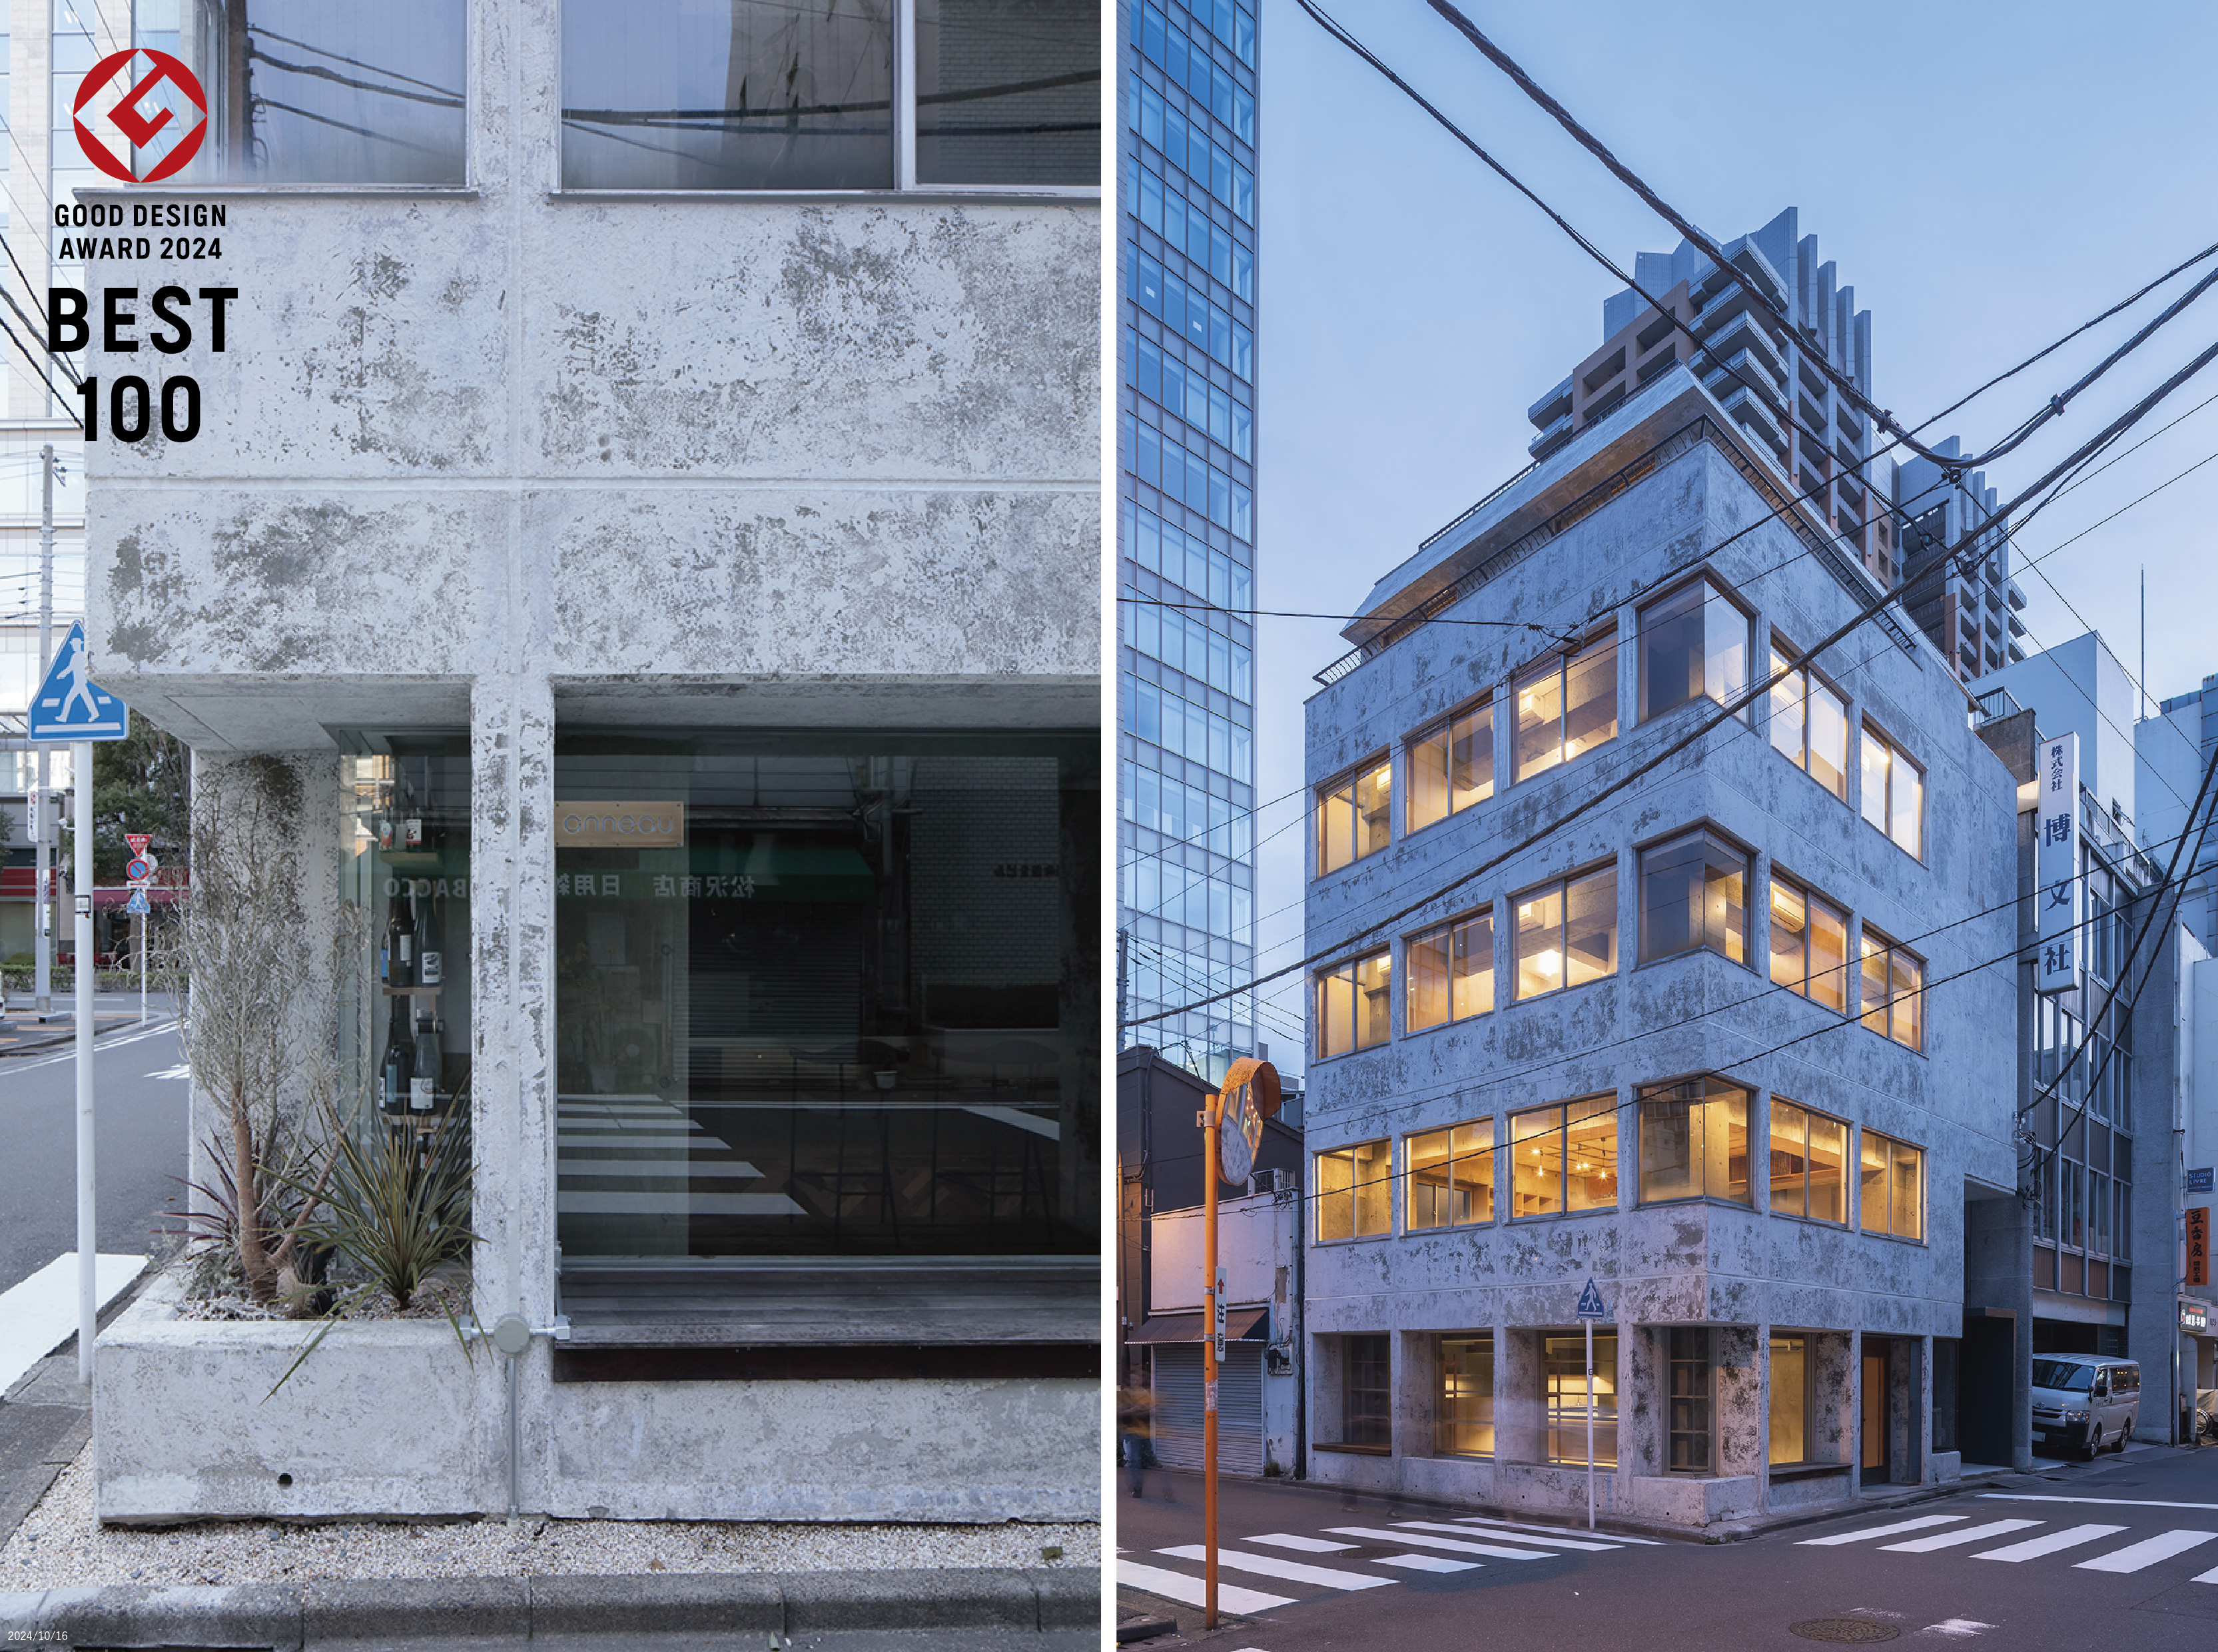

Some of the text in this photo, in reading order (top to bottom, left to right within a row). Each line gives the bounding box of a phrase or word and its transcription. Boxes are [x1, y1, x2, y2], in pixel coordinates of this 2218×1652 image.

[563, 815, 673, 833] anneau
[2044, 744, 2071, 977] 株式会社 博文社
[2190, 1210, 2204, 1257] 豆香房
